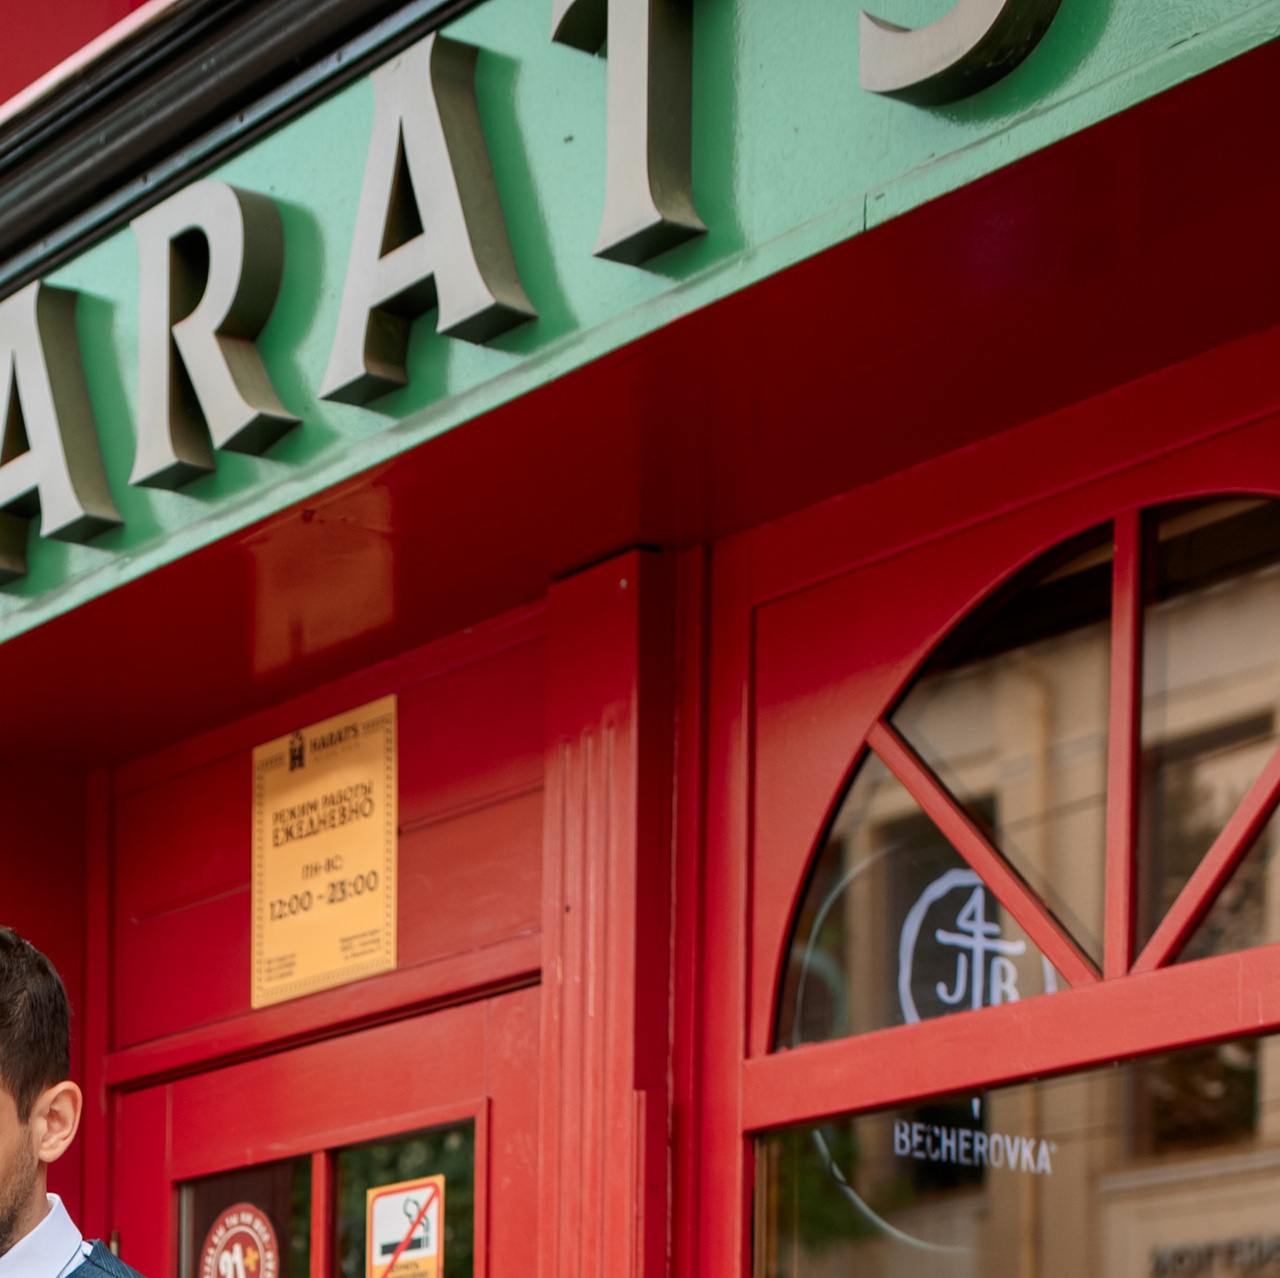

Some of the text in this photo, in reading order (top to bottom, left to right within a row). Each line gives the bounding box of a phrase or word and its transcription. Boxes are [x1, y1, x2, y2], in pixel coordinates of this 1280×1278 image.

[272, 779, 374, 825] РЕЖИМ РАБОТЫ
[272, 797, 375, 848] ЕЖЕДНЕВНО
[268, 890, 314, 921] 12:00
[327, 869, 380, 904] 23:00
